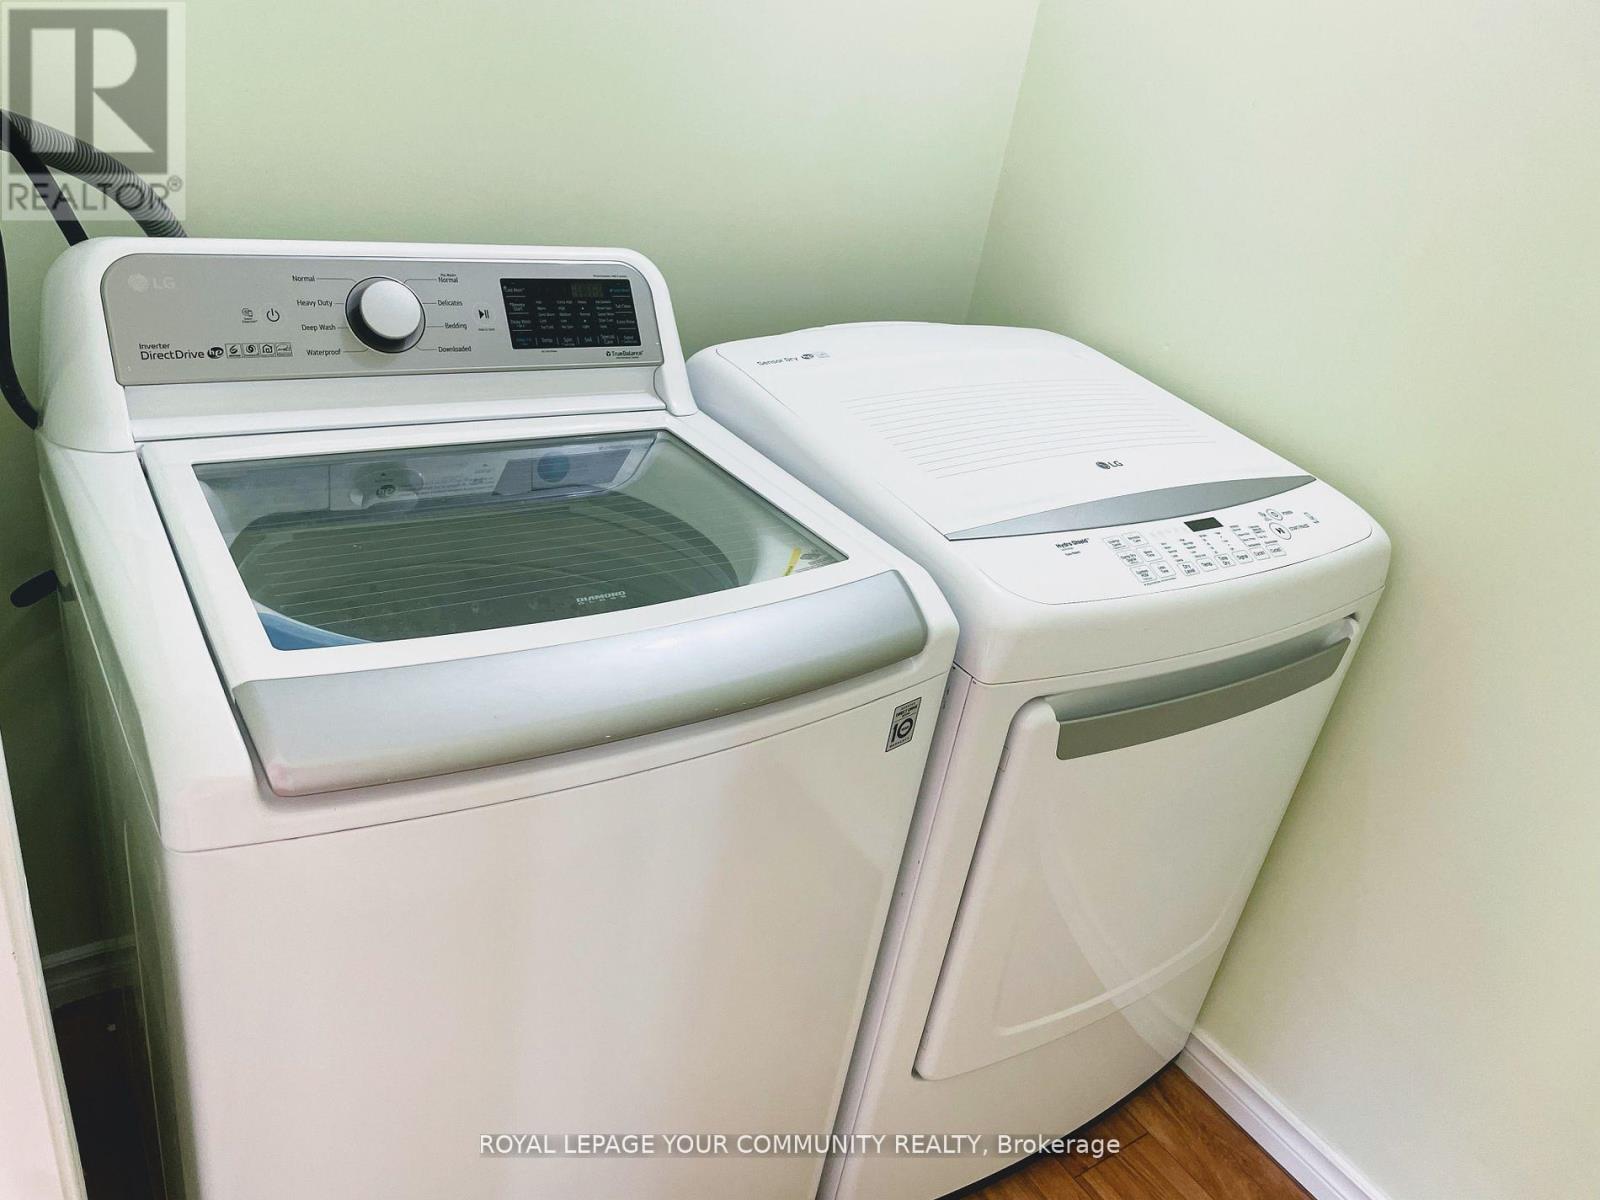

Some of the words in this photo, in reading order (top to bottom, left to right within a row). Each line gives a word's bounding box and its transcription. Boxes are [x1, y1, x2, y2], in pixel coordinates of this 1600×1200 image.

[152, 276, 176, 290] LG
[438, 276, 459, 284] Normal
[297, 300, 316, 308] Heavy
[317, 300, 333, 308] Duty
[301, 324, 318, 332] Deep
[444, 322, 468, 330] Bedding
[138, 342, 171, 350] Inverter
[438, 345, 472, 353] Downloaded
[140, 349, 205, 361] DirectDrive
[306, 348, 341, 357] Waterproof
[1107, 460, 1124, 468] LG
